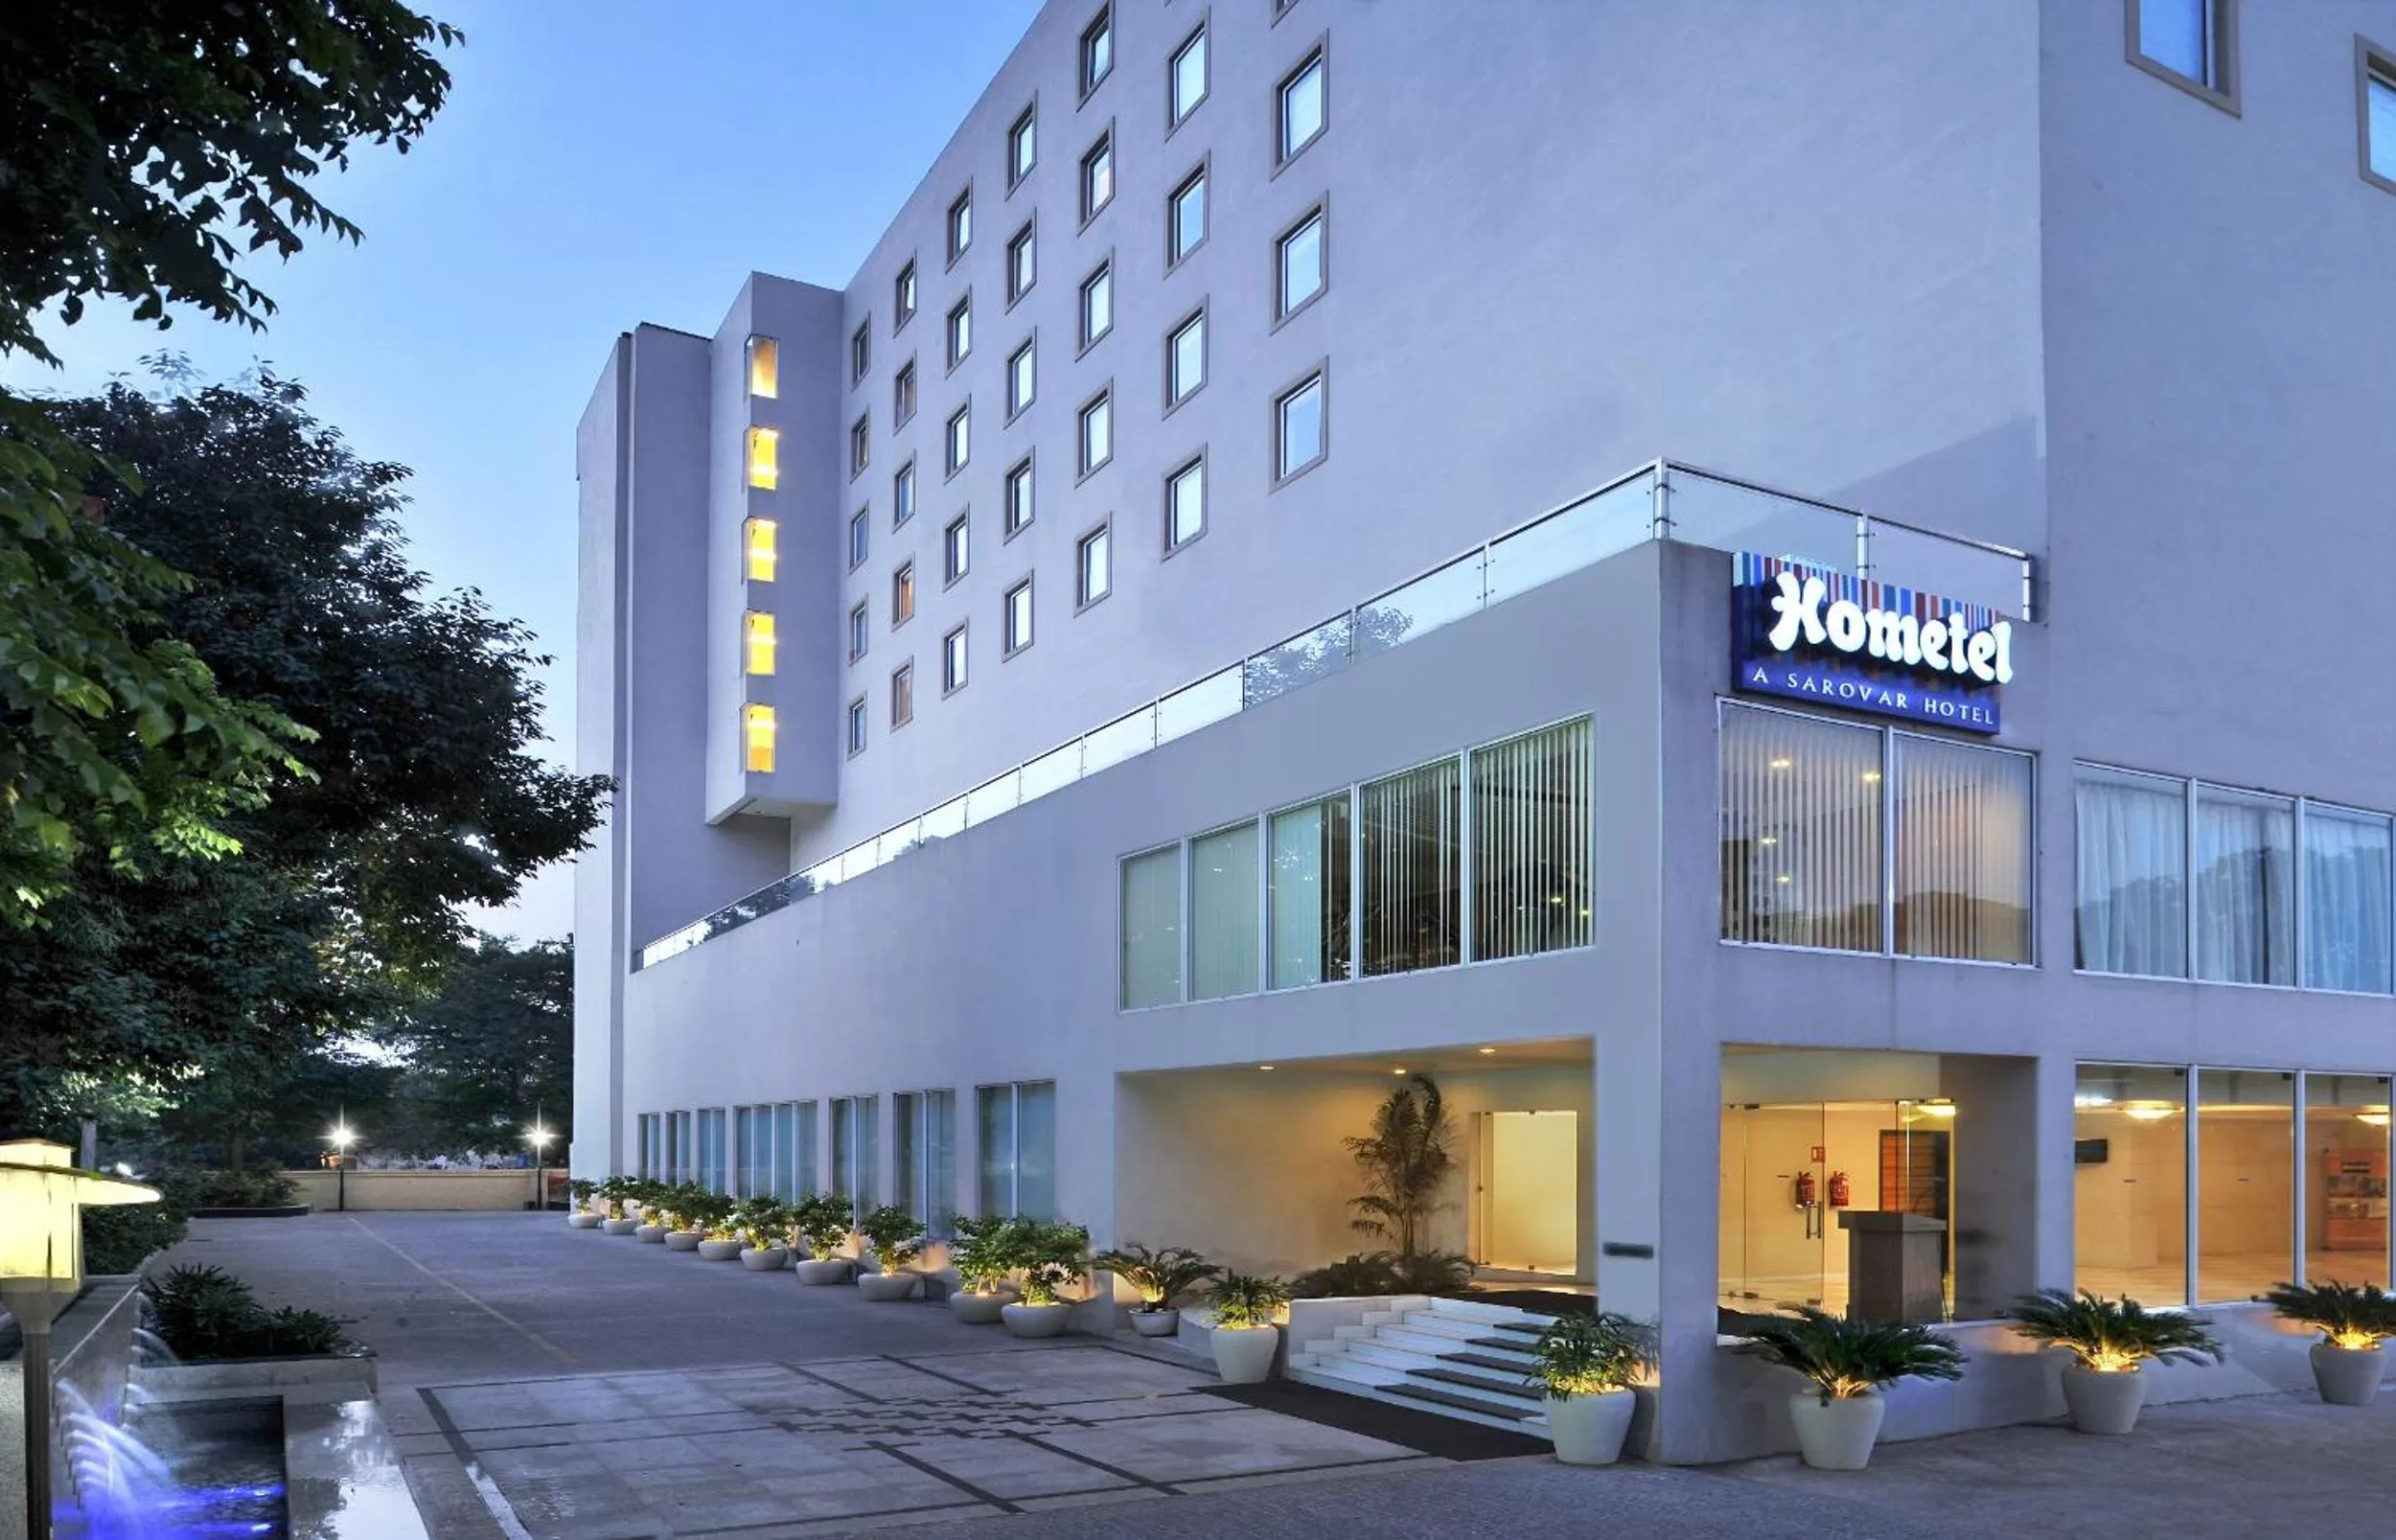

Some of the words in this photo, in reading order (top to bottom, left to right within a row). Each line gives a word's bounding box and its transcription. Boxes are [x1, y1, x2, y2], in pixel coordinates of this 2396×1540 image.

[1769, 571, 2013, 684] Hometel
[1753, 667, 1768, 683] A
[1788, 673, 1907, 708] SAROVAR
[1924, 698, 1993, 724] HOTEL
